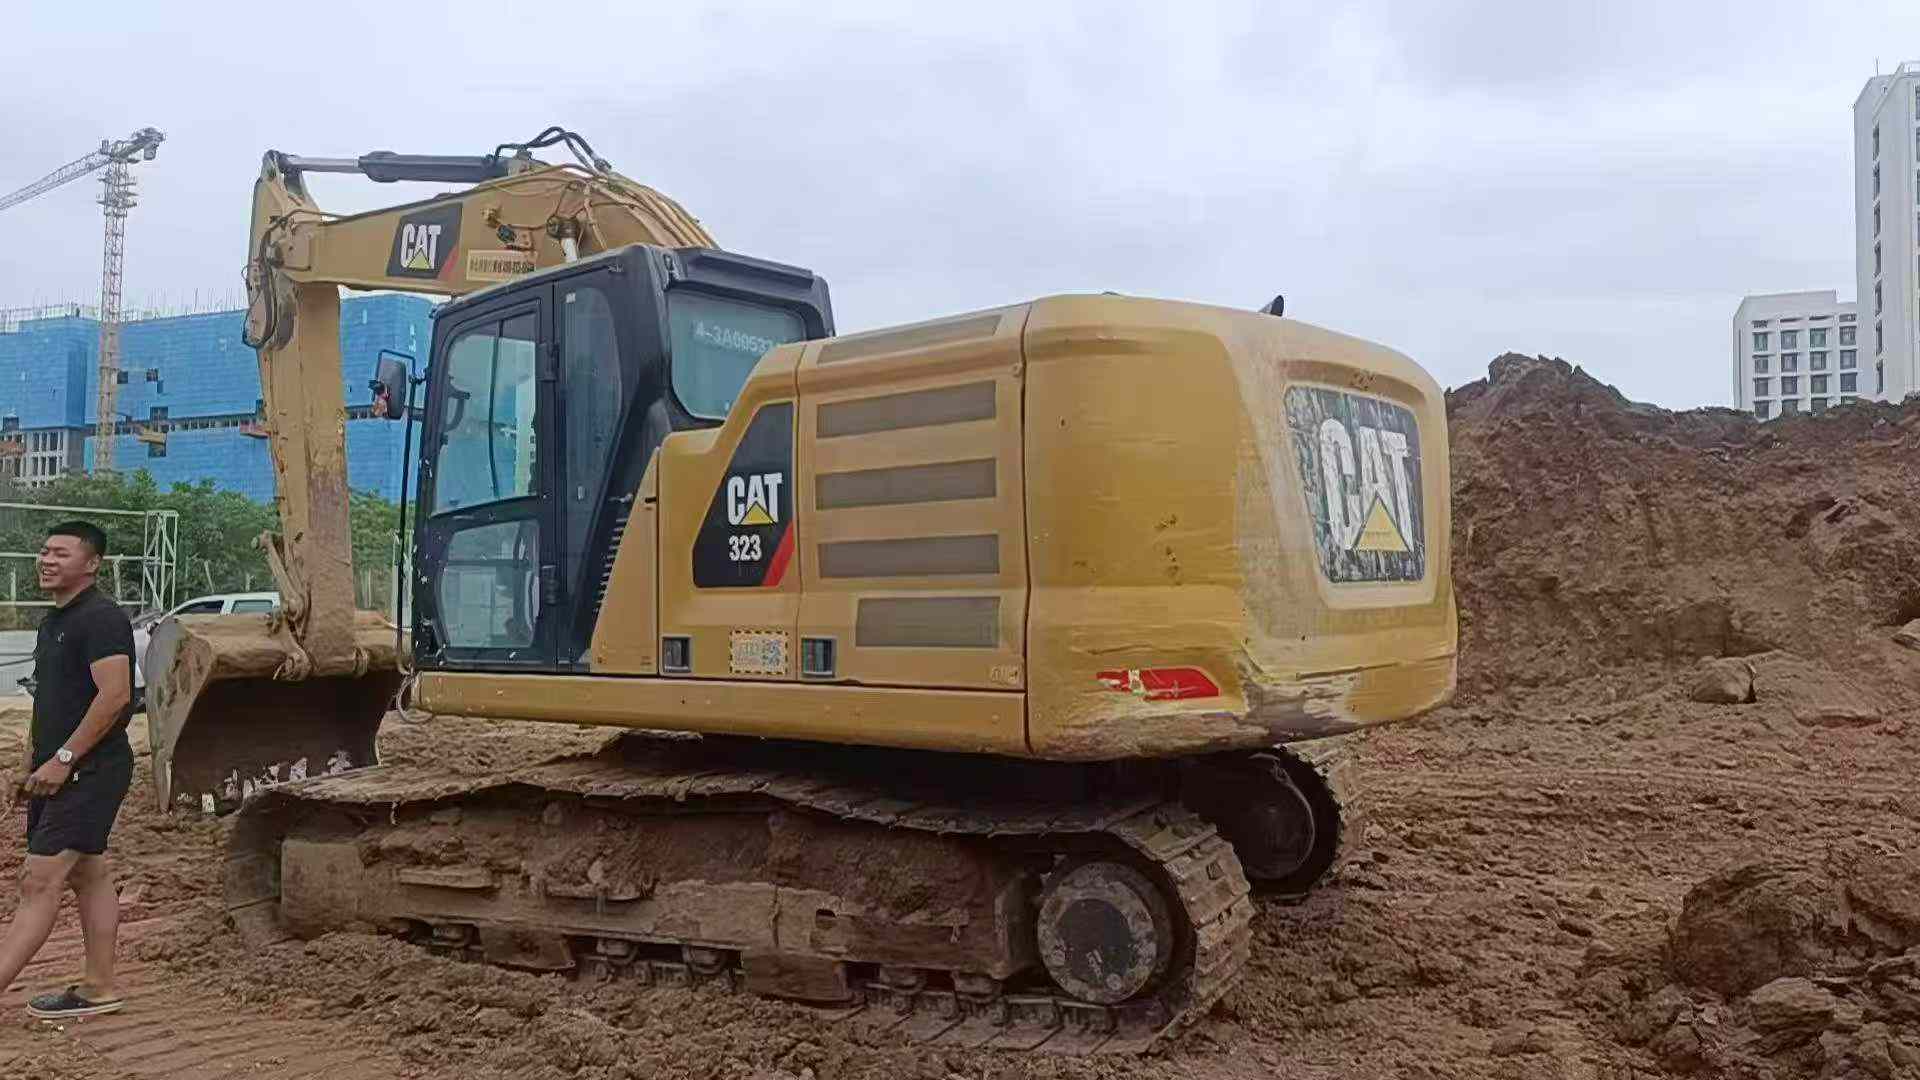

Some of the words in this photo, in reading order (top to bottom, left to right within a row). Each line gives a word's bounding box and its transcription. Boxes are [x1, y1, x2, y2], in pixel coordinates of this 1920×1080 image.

[400, 223, 442, 269] CAT
[727, 472, 782, 525] CAT
[1319, 418, 1415, 551] CAT
[728, 534, 762, 561] 323
